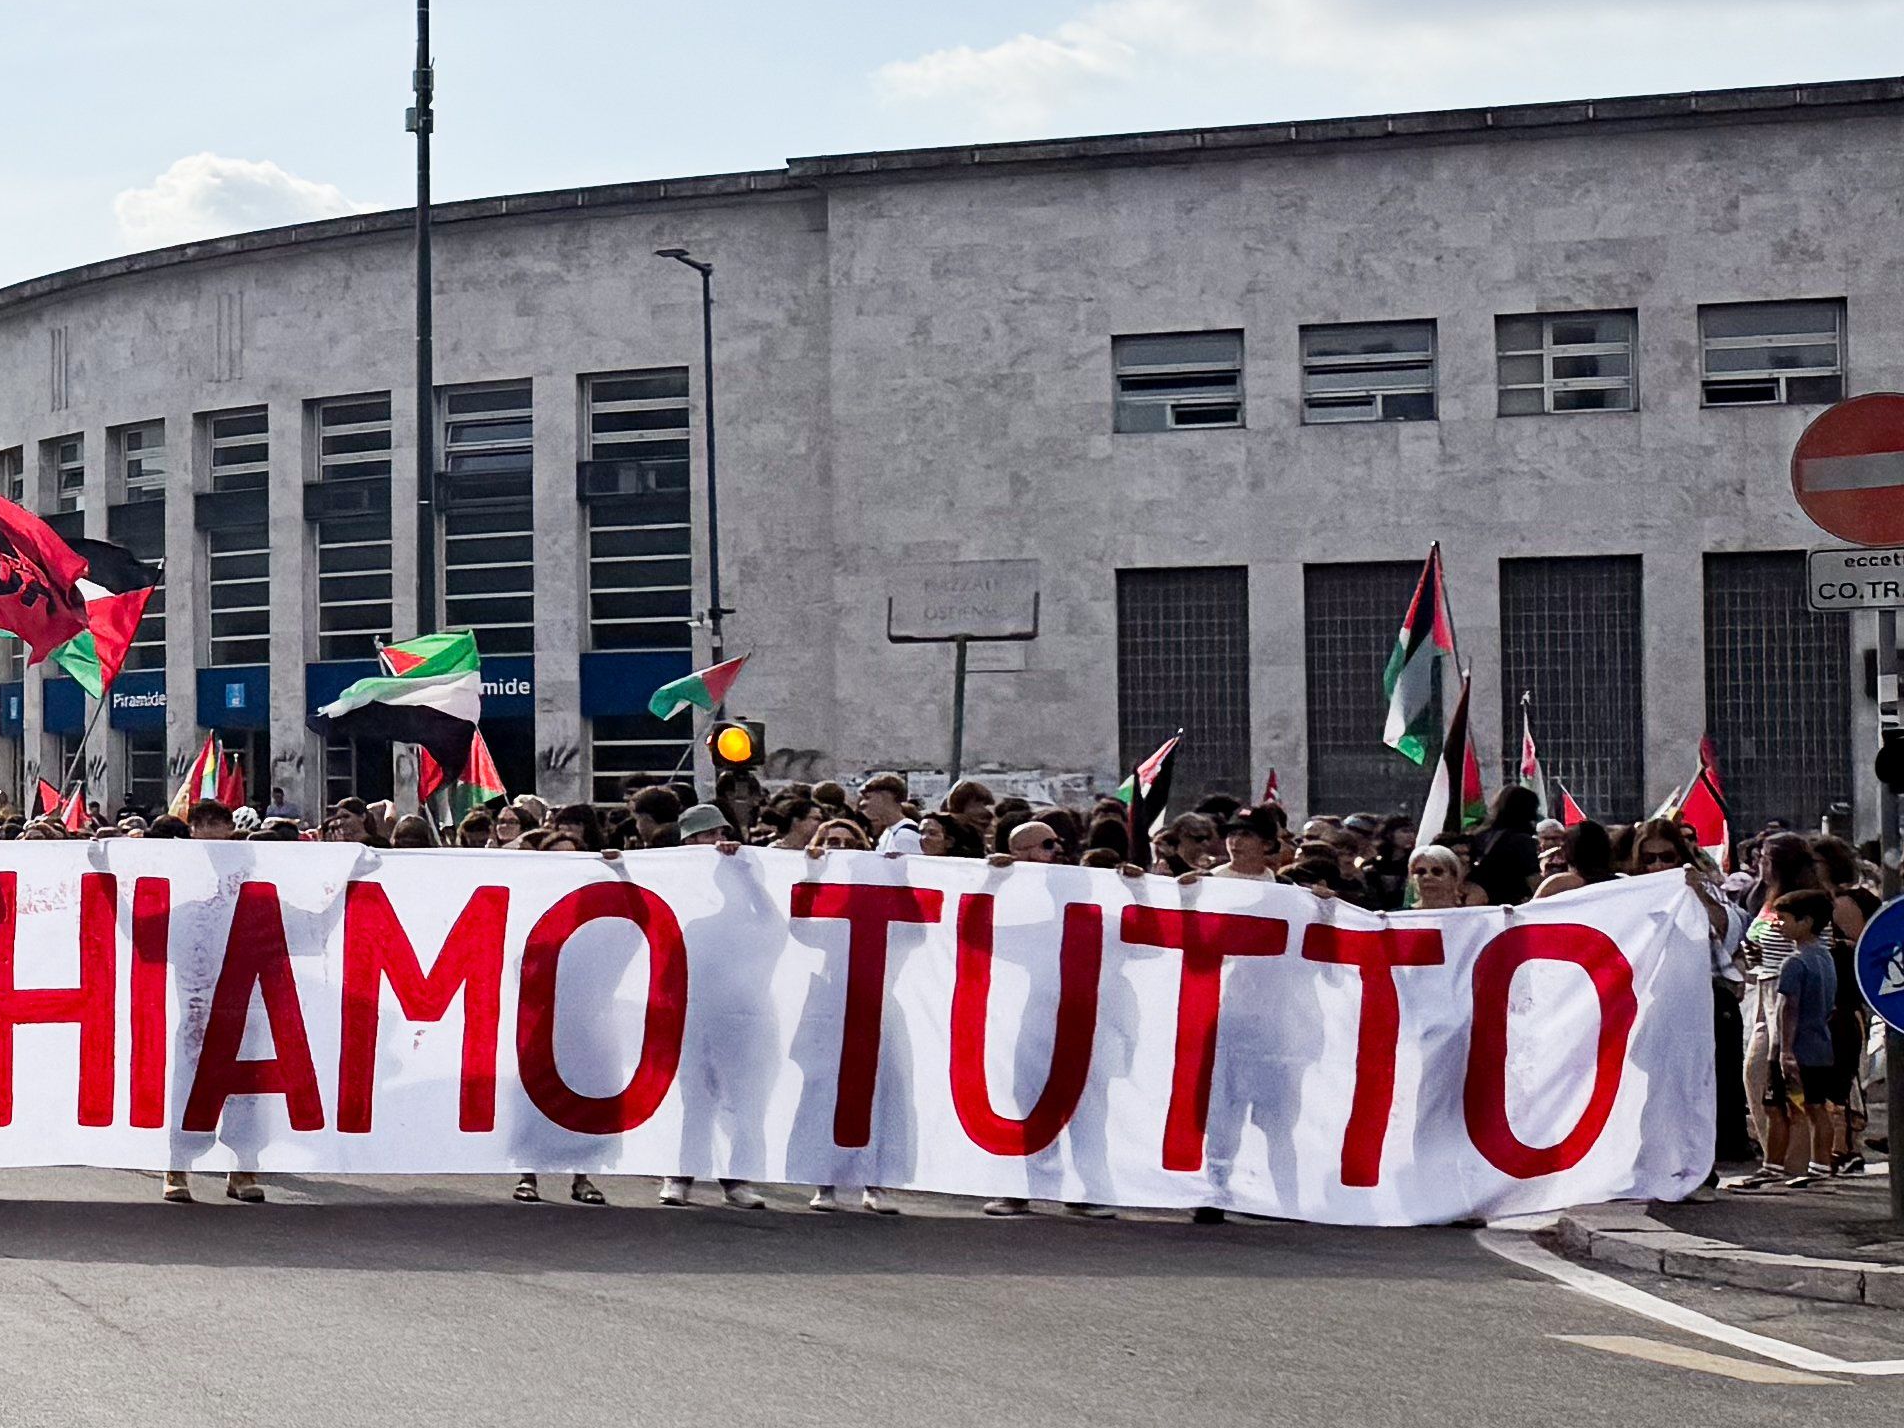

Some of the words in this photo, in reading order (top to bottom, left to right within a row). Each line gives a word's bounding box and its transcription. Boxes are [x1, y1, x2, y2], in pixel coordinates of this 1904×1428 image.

[1844, 552, 1904, 568] eccet
[1818, 581, 1904, 600] CO.TR
[113, 691, 168, 709] Piramide
[790, 882, 1639, 1188] TUTTO
